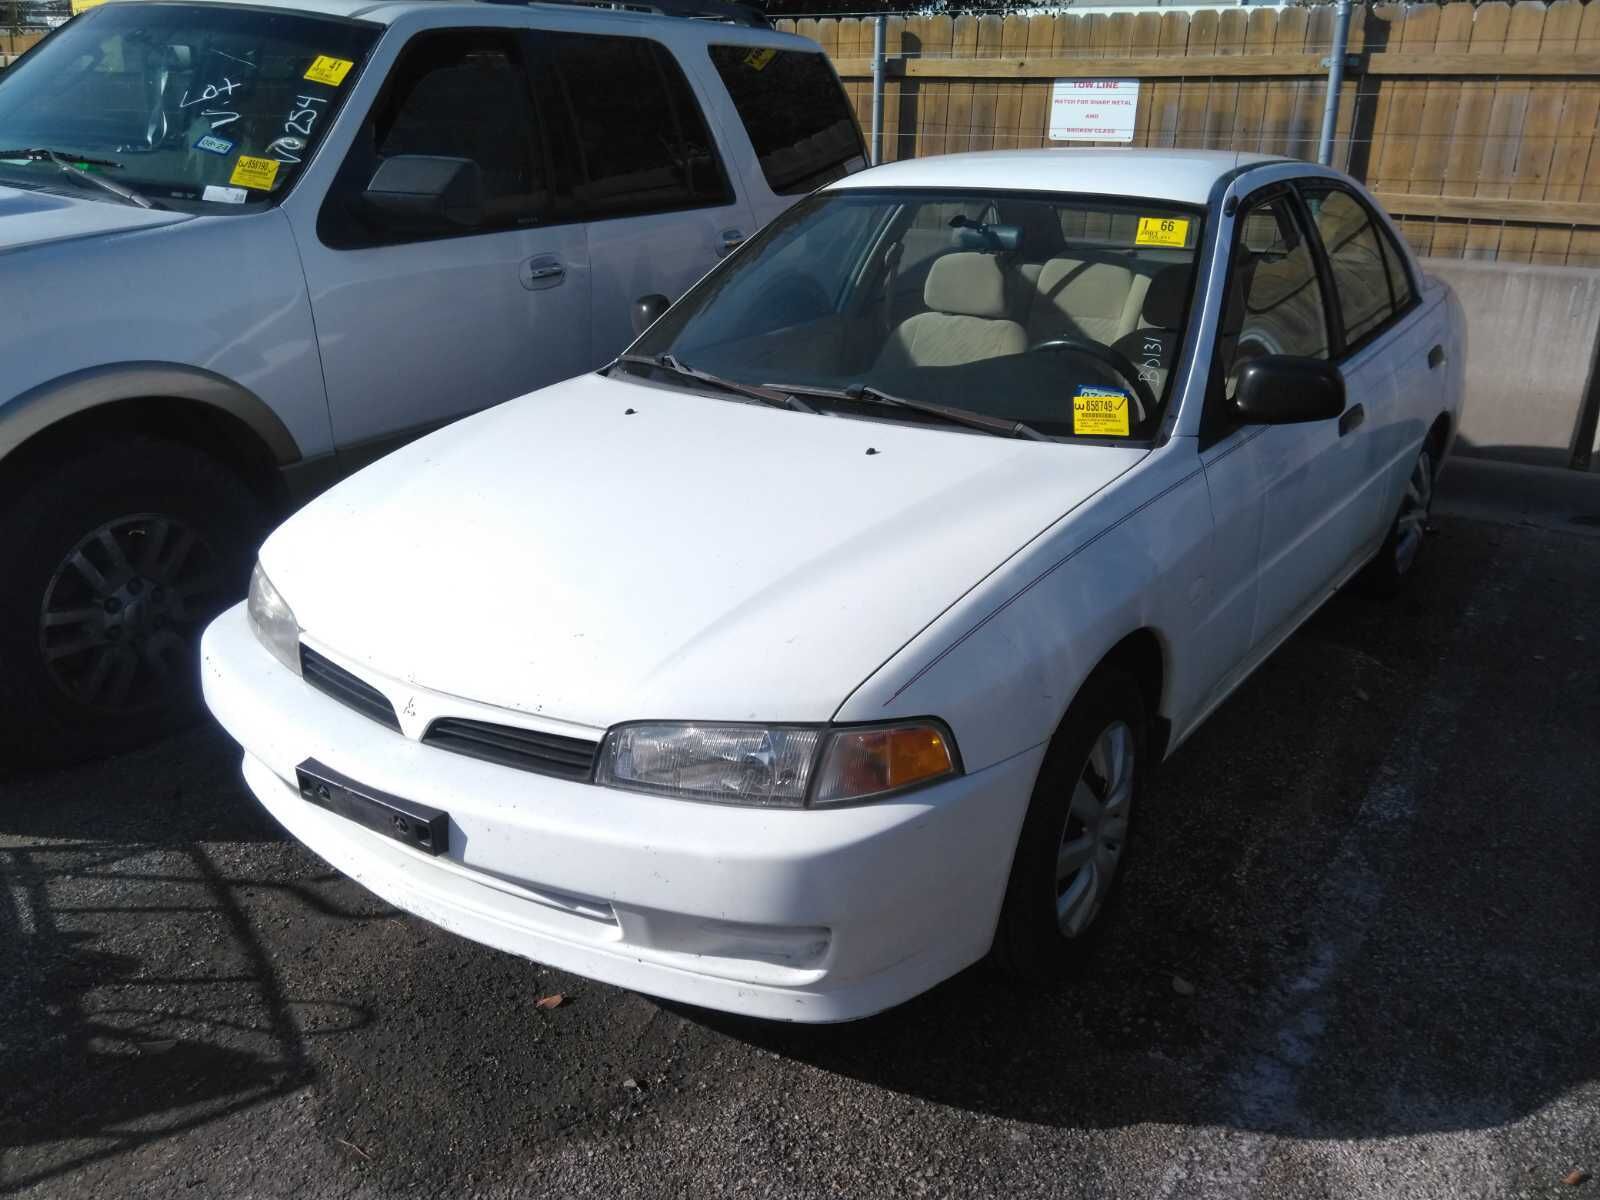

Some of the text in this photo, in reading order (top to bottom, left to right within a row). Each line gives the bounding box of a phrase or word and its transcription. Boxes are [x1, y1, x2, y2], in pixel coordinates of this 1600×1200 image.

[1072, 80, 1119, 89] TOW LINE
[1160, 221, 1176, 232] 66
[1086, 400, 1113, 412] 858749
